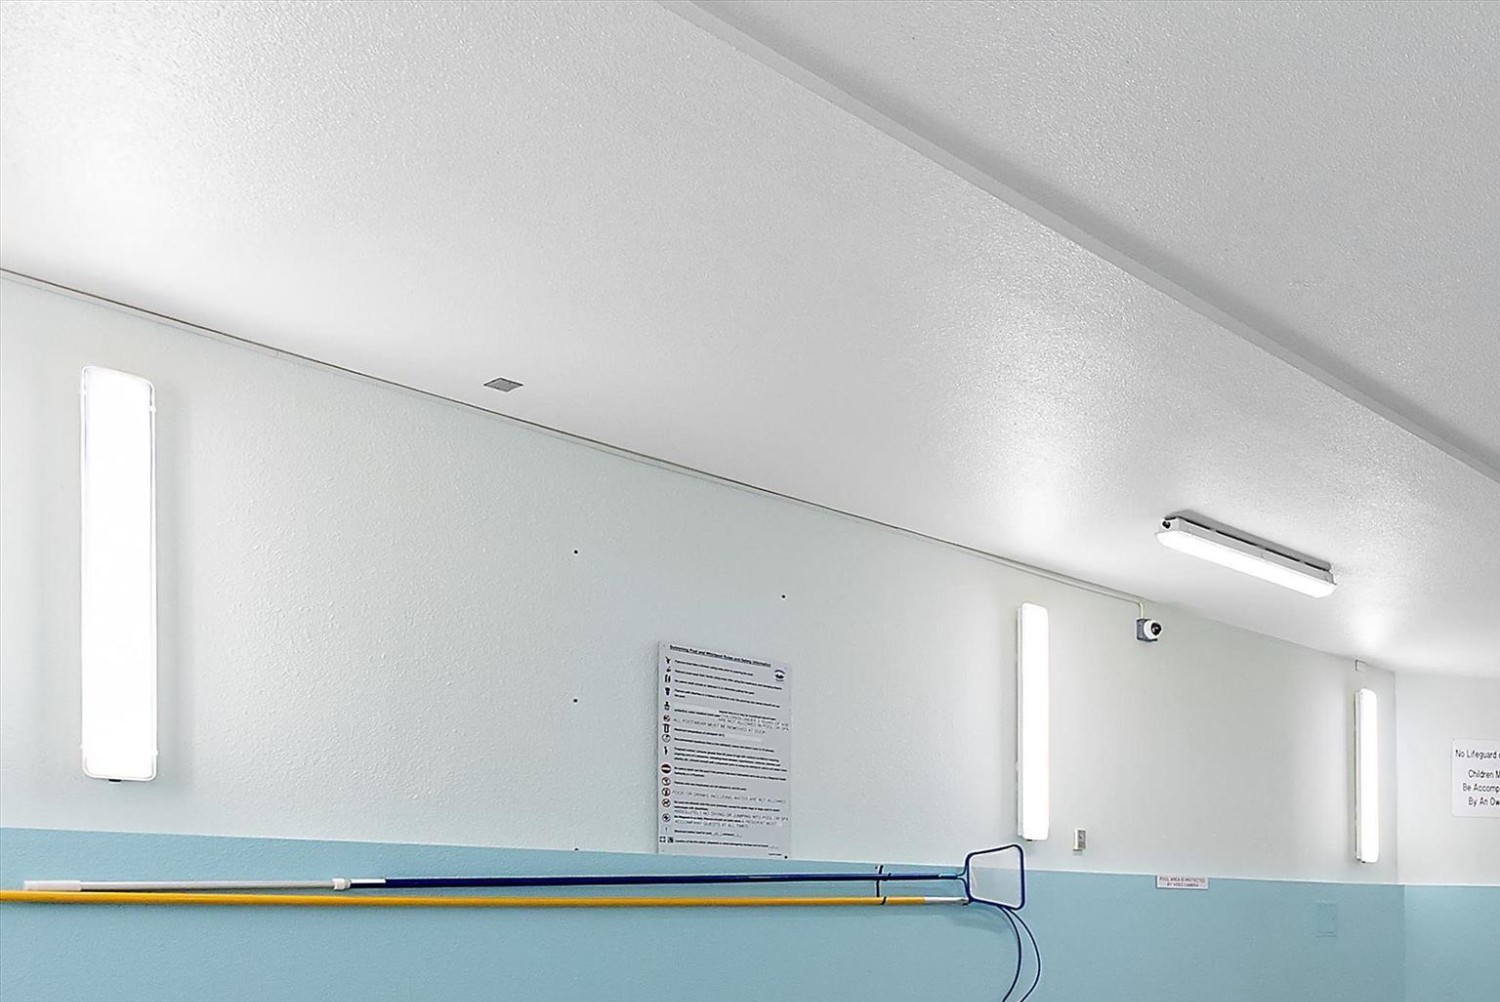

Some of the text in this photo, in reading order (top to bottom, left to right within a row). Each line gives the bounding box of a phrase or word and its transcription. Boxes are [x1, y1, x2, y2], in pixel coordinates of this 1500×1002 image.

[1455, 749, 1465, 758] No
[1466, 750, 1497, 761] Lifeguard
[1468, 769, 1494, 779] Children
[1462, 782, 1472, 792] Be
[1468, 796, 1477, 807] By
[1479, 797, 1488, 806] An
